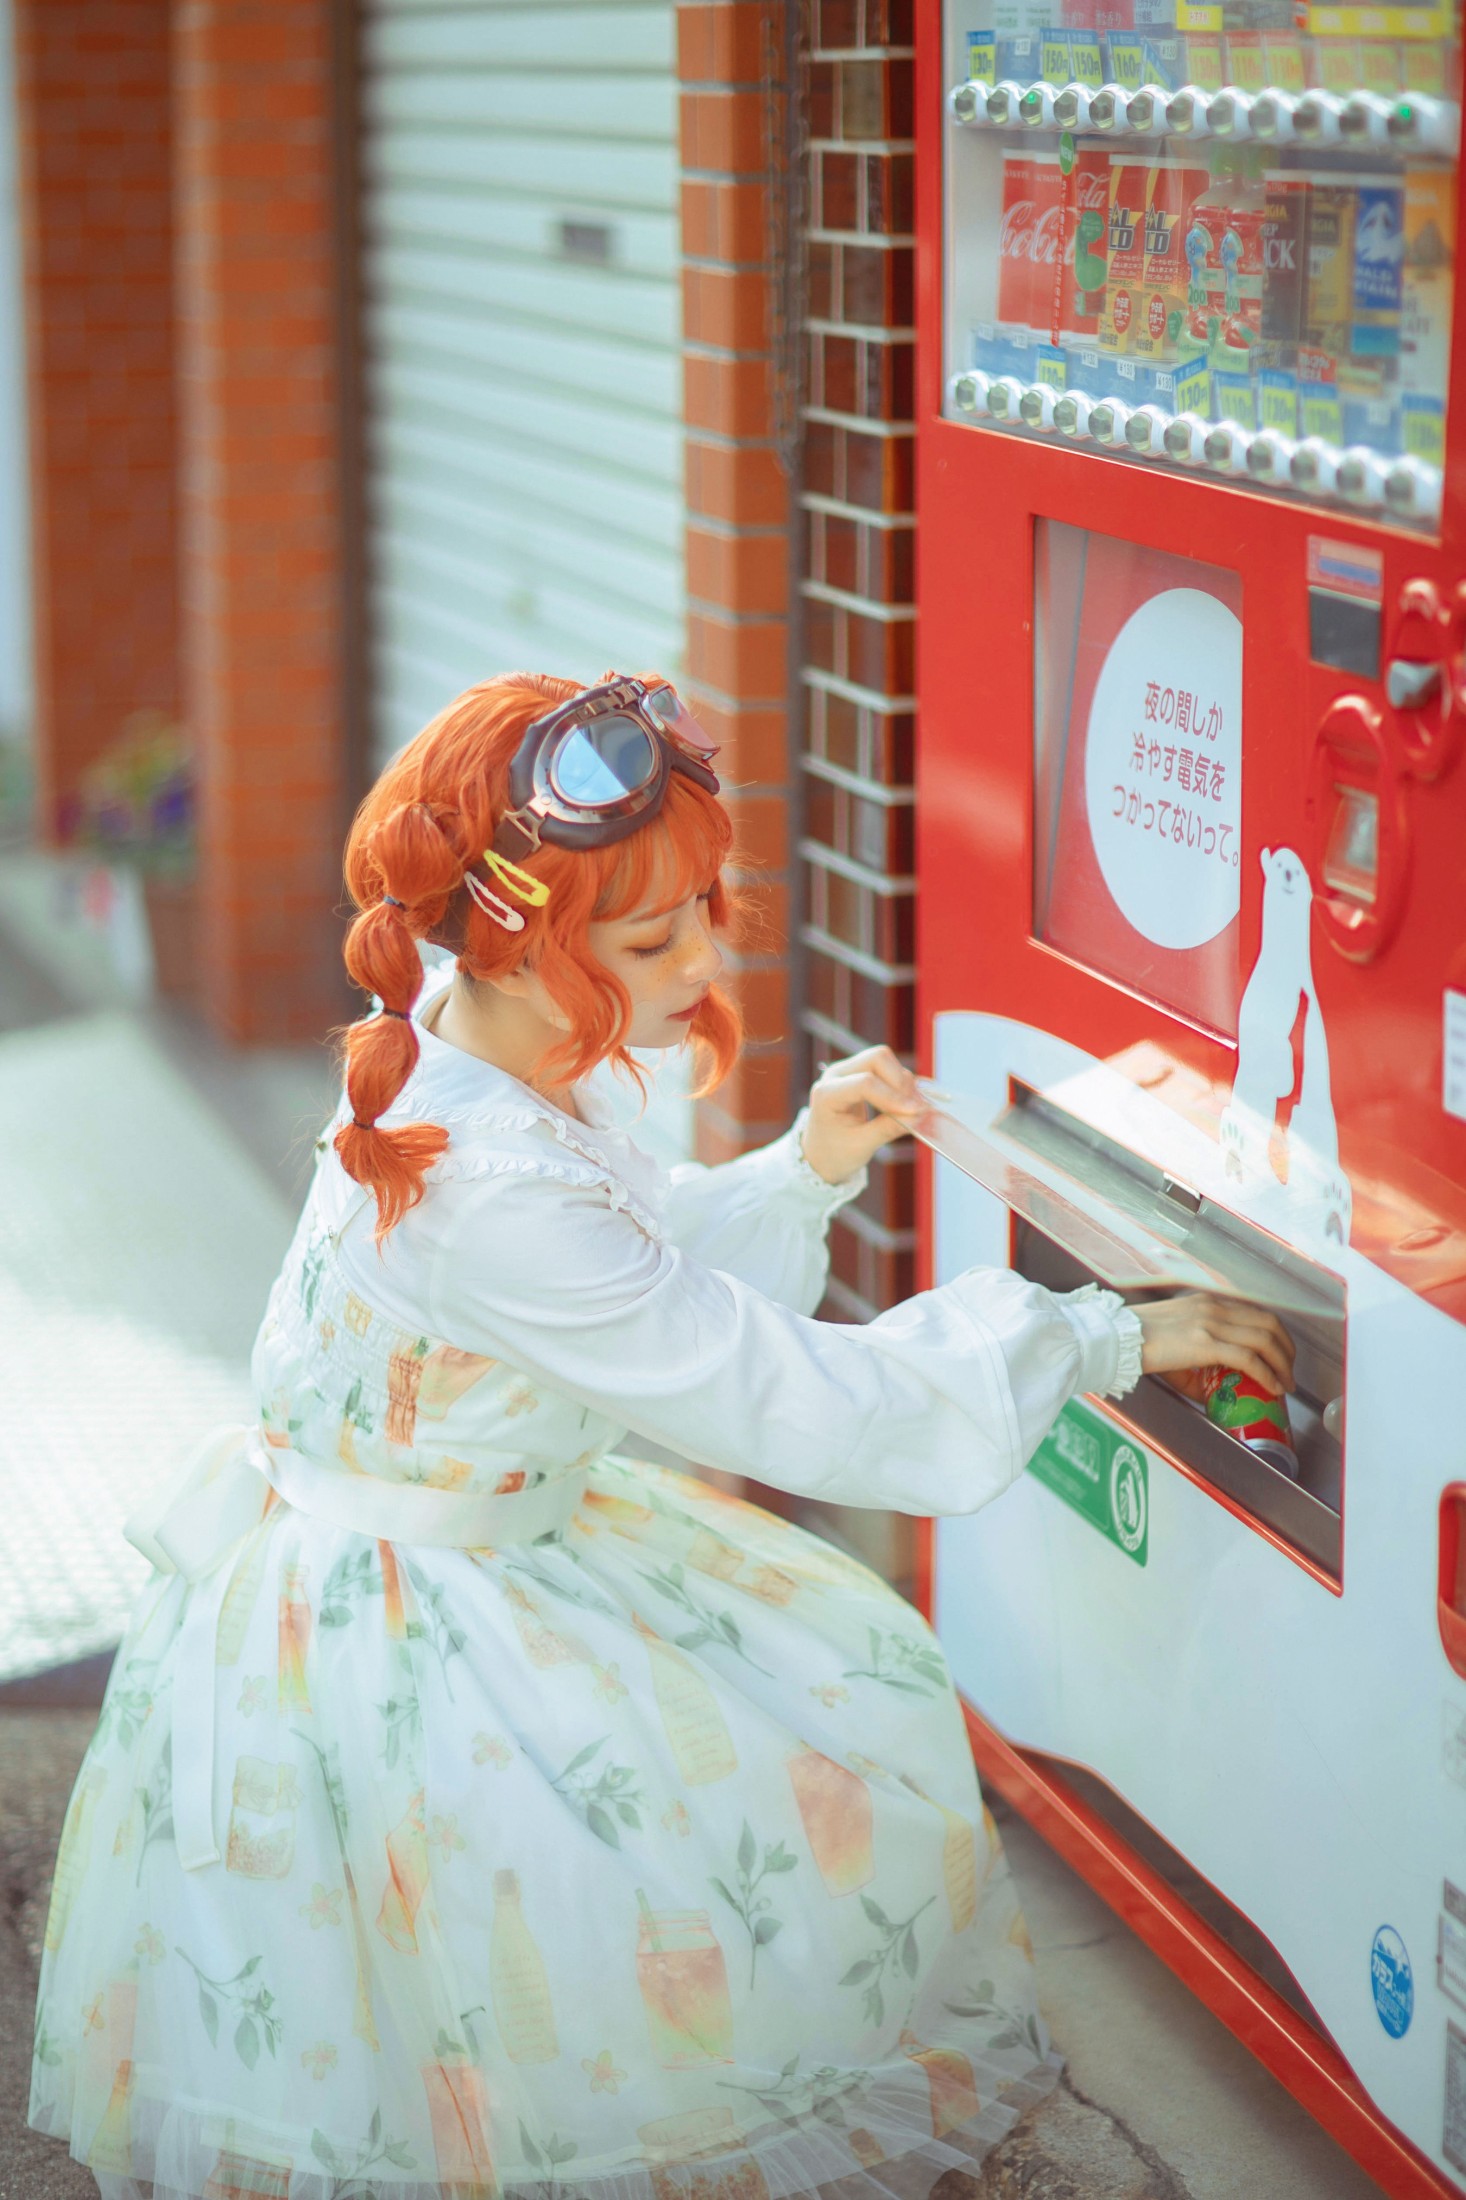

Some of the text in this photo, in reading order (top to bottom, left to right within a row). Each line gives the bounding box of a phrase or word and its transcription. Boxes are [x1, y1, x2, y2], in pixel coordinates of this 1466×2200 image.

[1145, 681, 1222, 741] 夜の間しか
[1129, 731, 1225, 802] 冷やす電気を
[1112, 784, 1239, 867] つかってないって。
